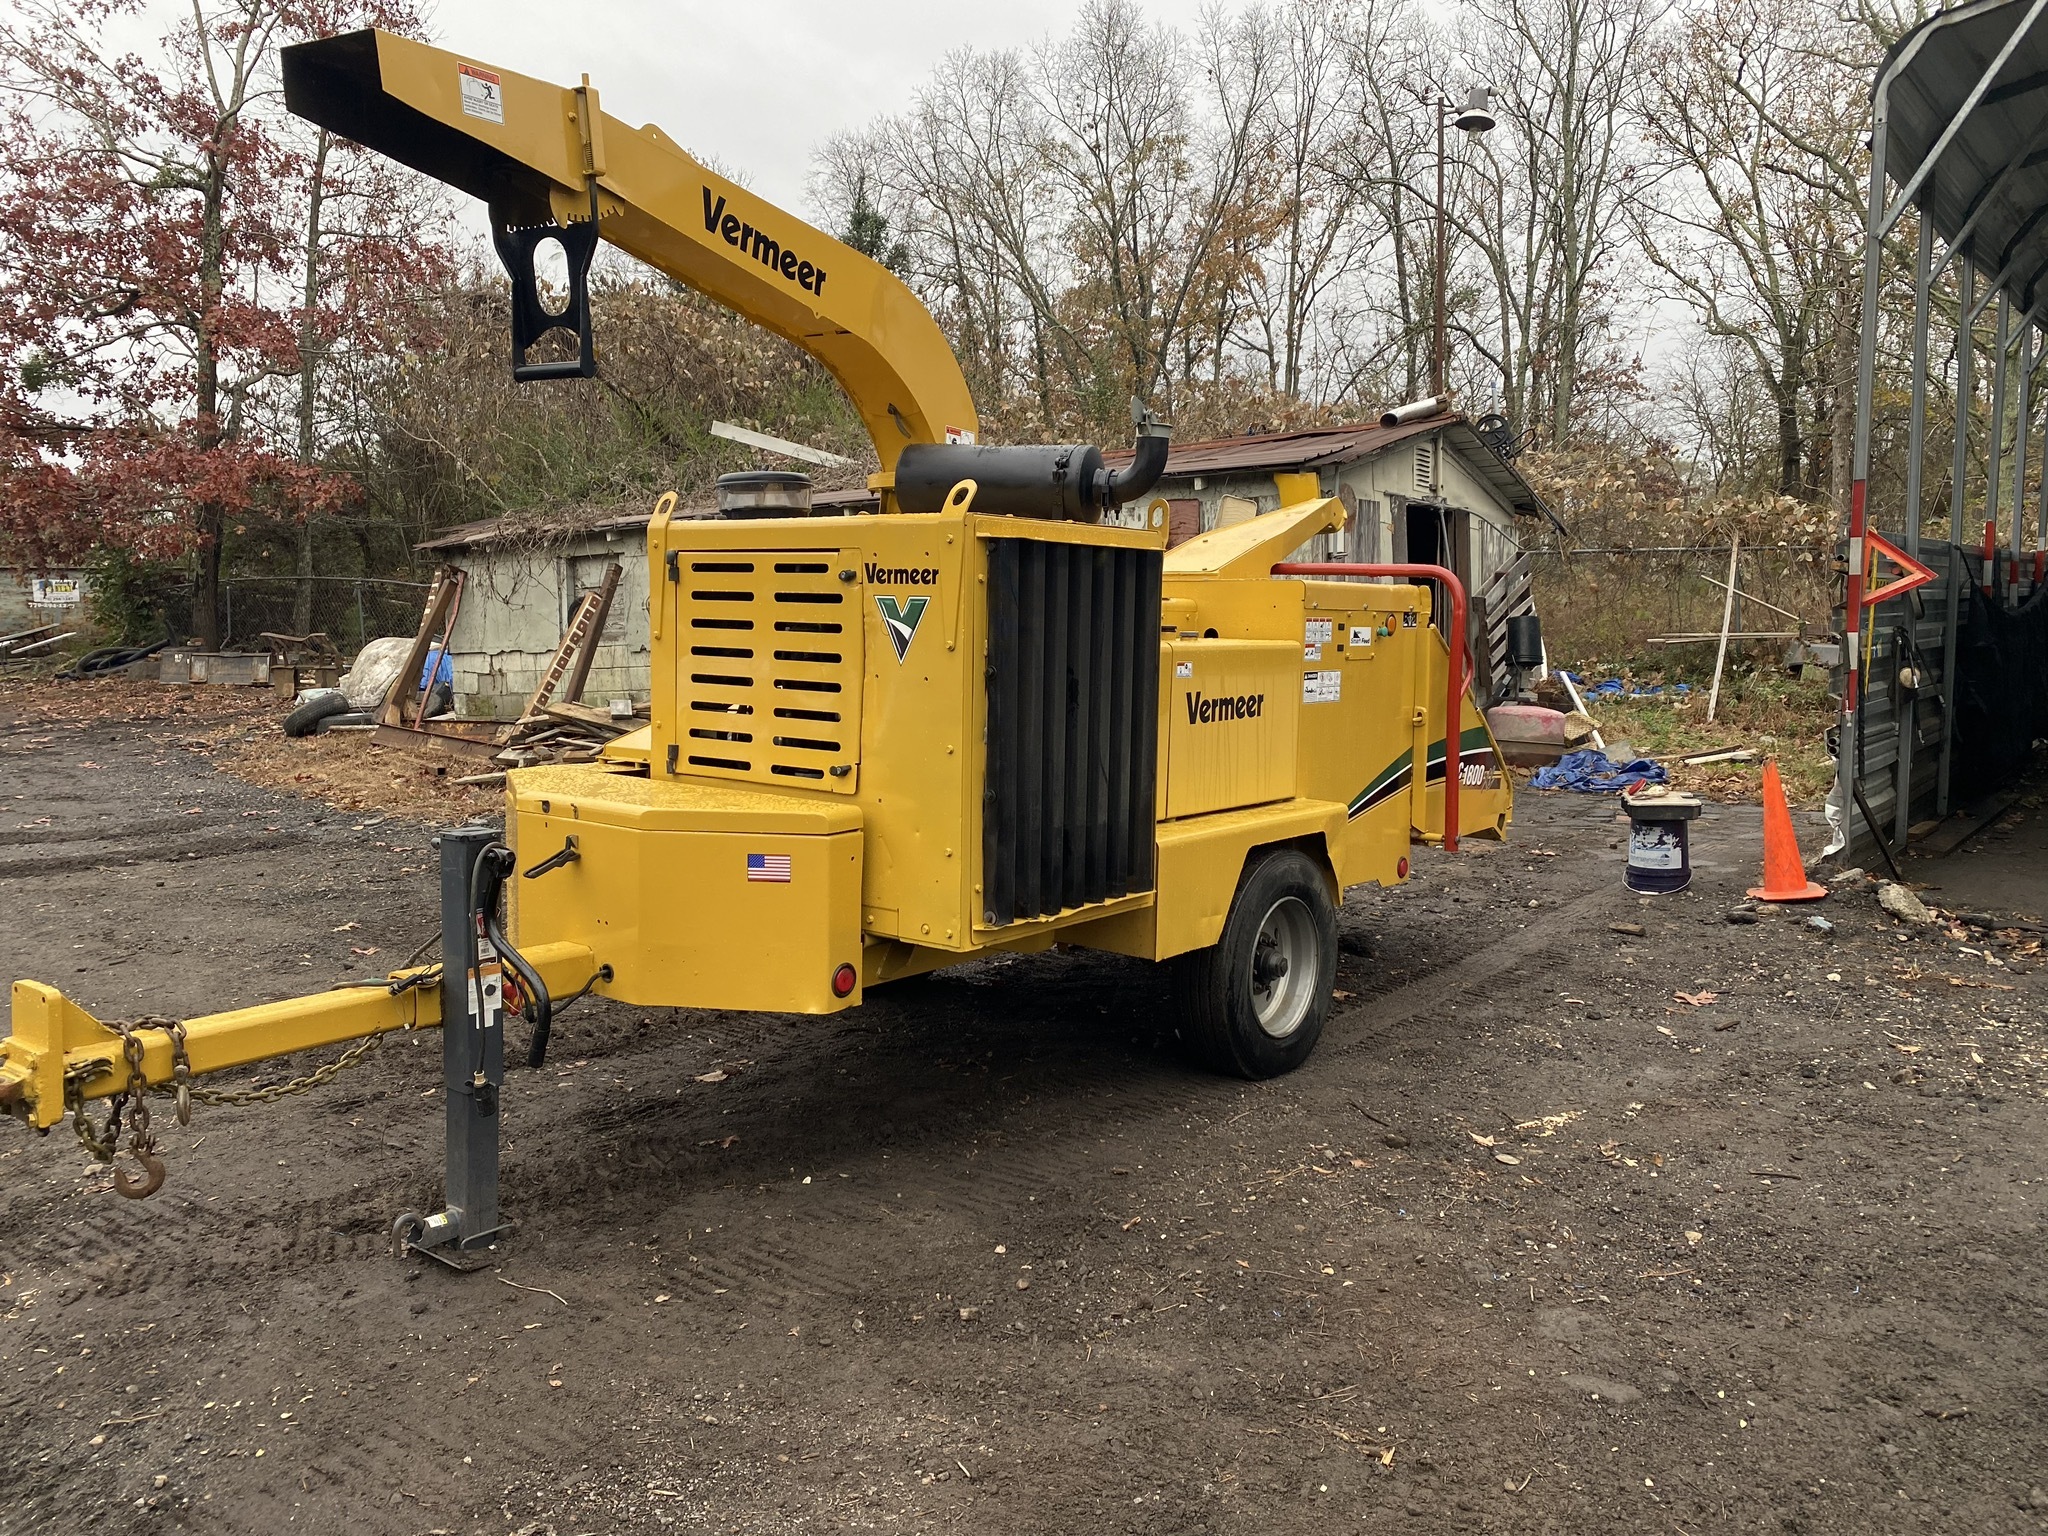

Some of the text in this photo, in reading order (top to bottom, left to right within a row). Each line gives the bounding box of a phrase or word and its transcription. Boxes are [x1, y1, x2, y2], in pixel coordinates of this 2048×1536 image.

[702, 185, 827, 297] Vermeer
[864, 562, 939, 585] Vermeer
[1186, 691, 1264, 724] Vermeer
